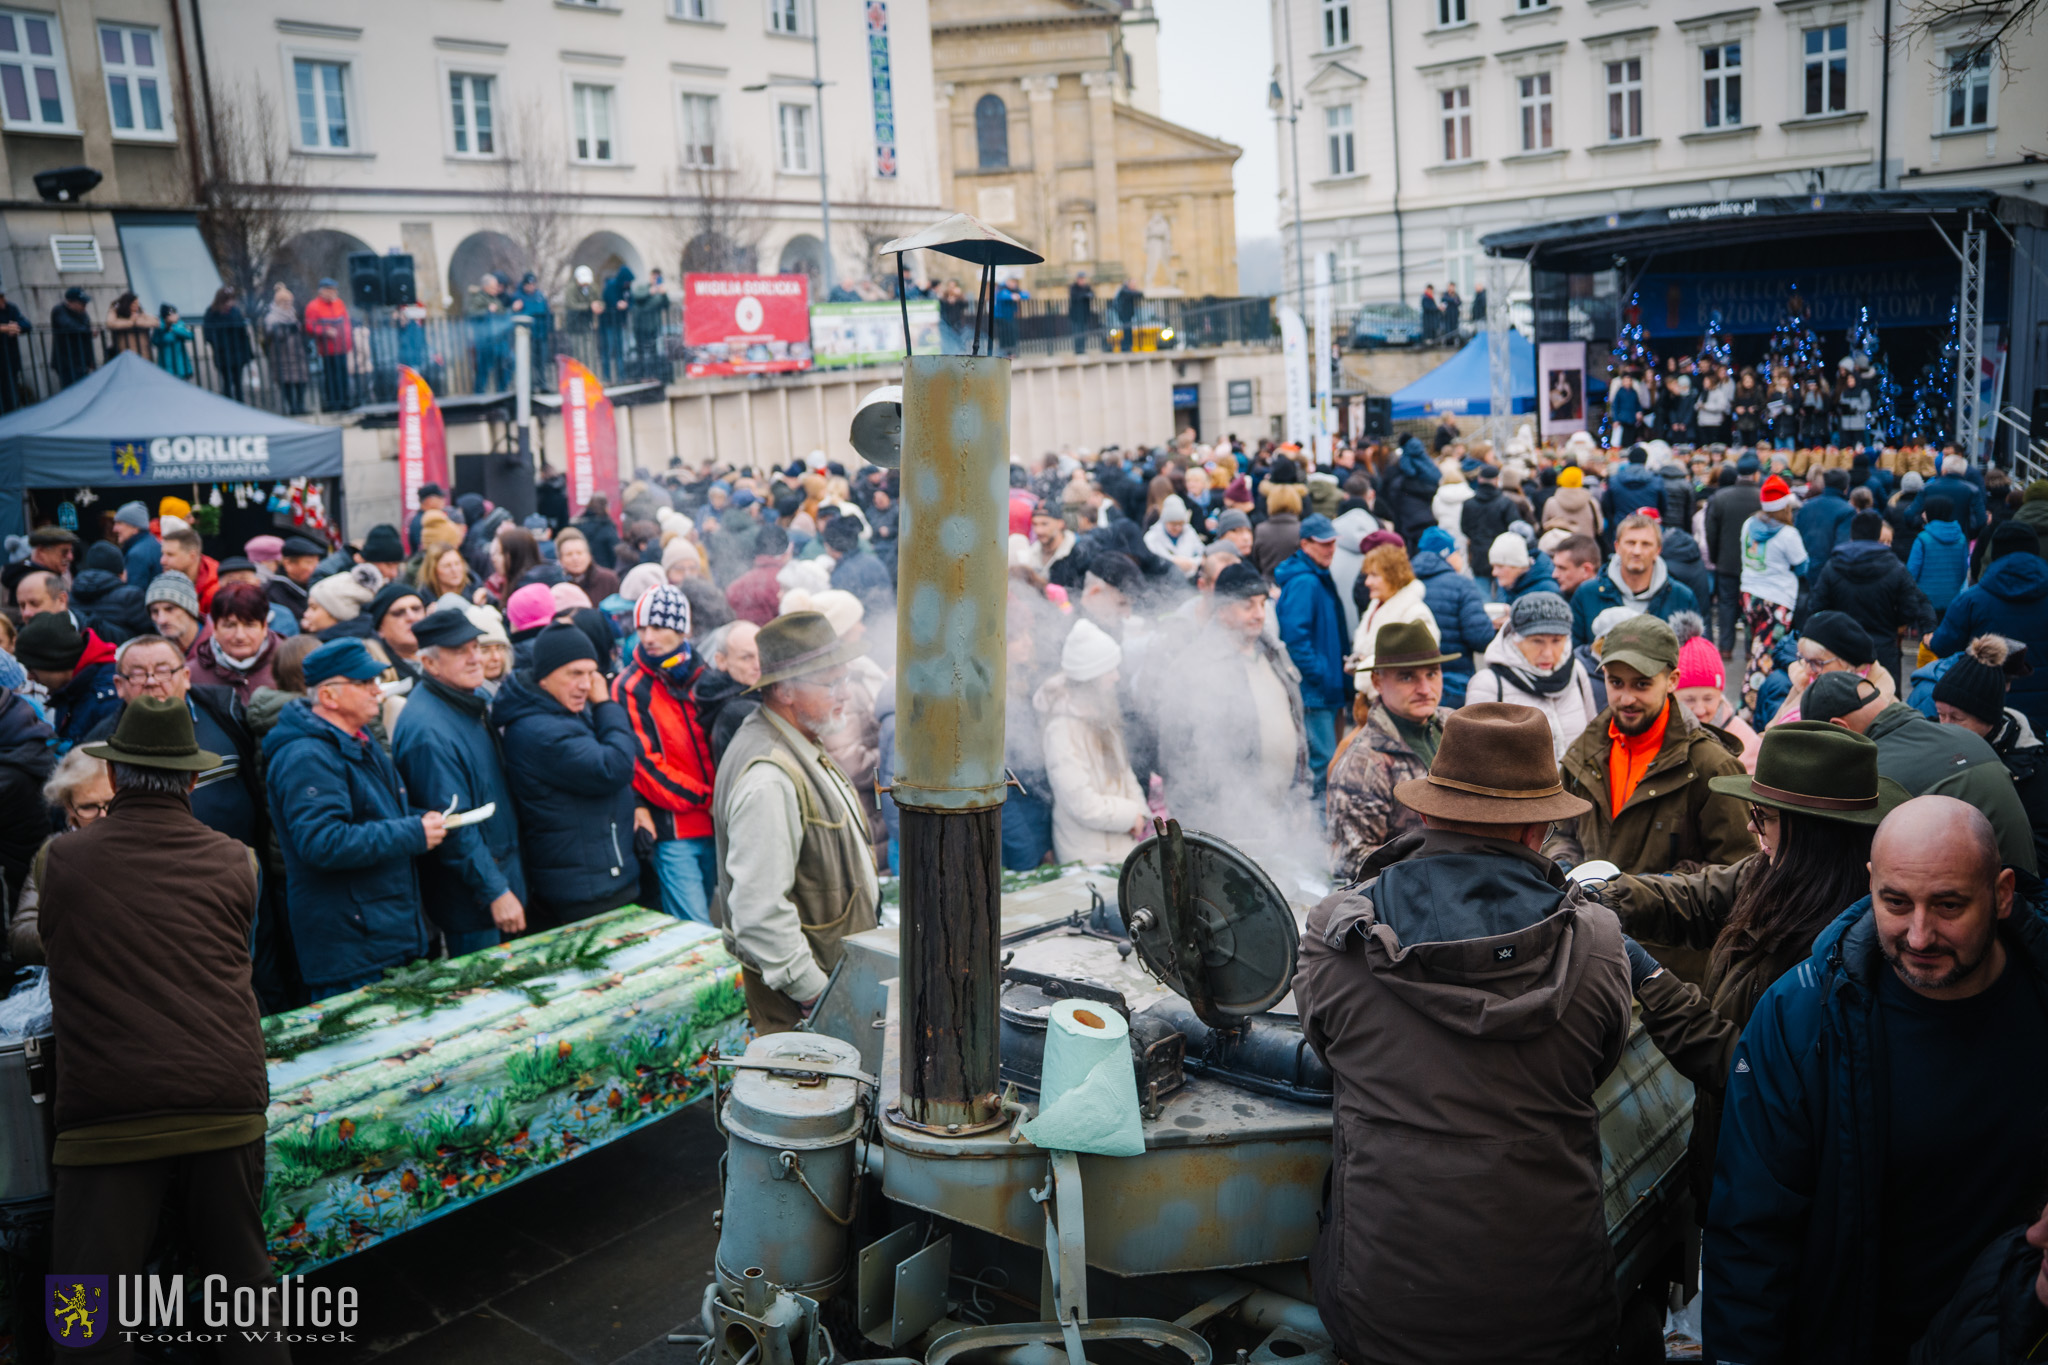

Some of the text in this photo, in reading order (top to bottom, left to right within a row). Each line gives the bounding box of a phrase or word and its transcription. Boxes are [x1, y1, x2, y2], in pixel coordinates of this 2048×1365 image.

[869, 35, 894, 143] APTEKA
[1668, 199, 1757, 220] www.gorlice.pl
[694, 280, 801, 296] WIGILIA GORLICKA
[150, 435, 269, 463] GORLICE
[153, 464, 209, 480] MIASTO
